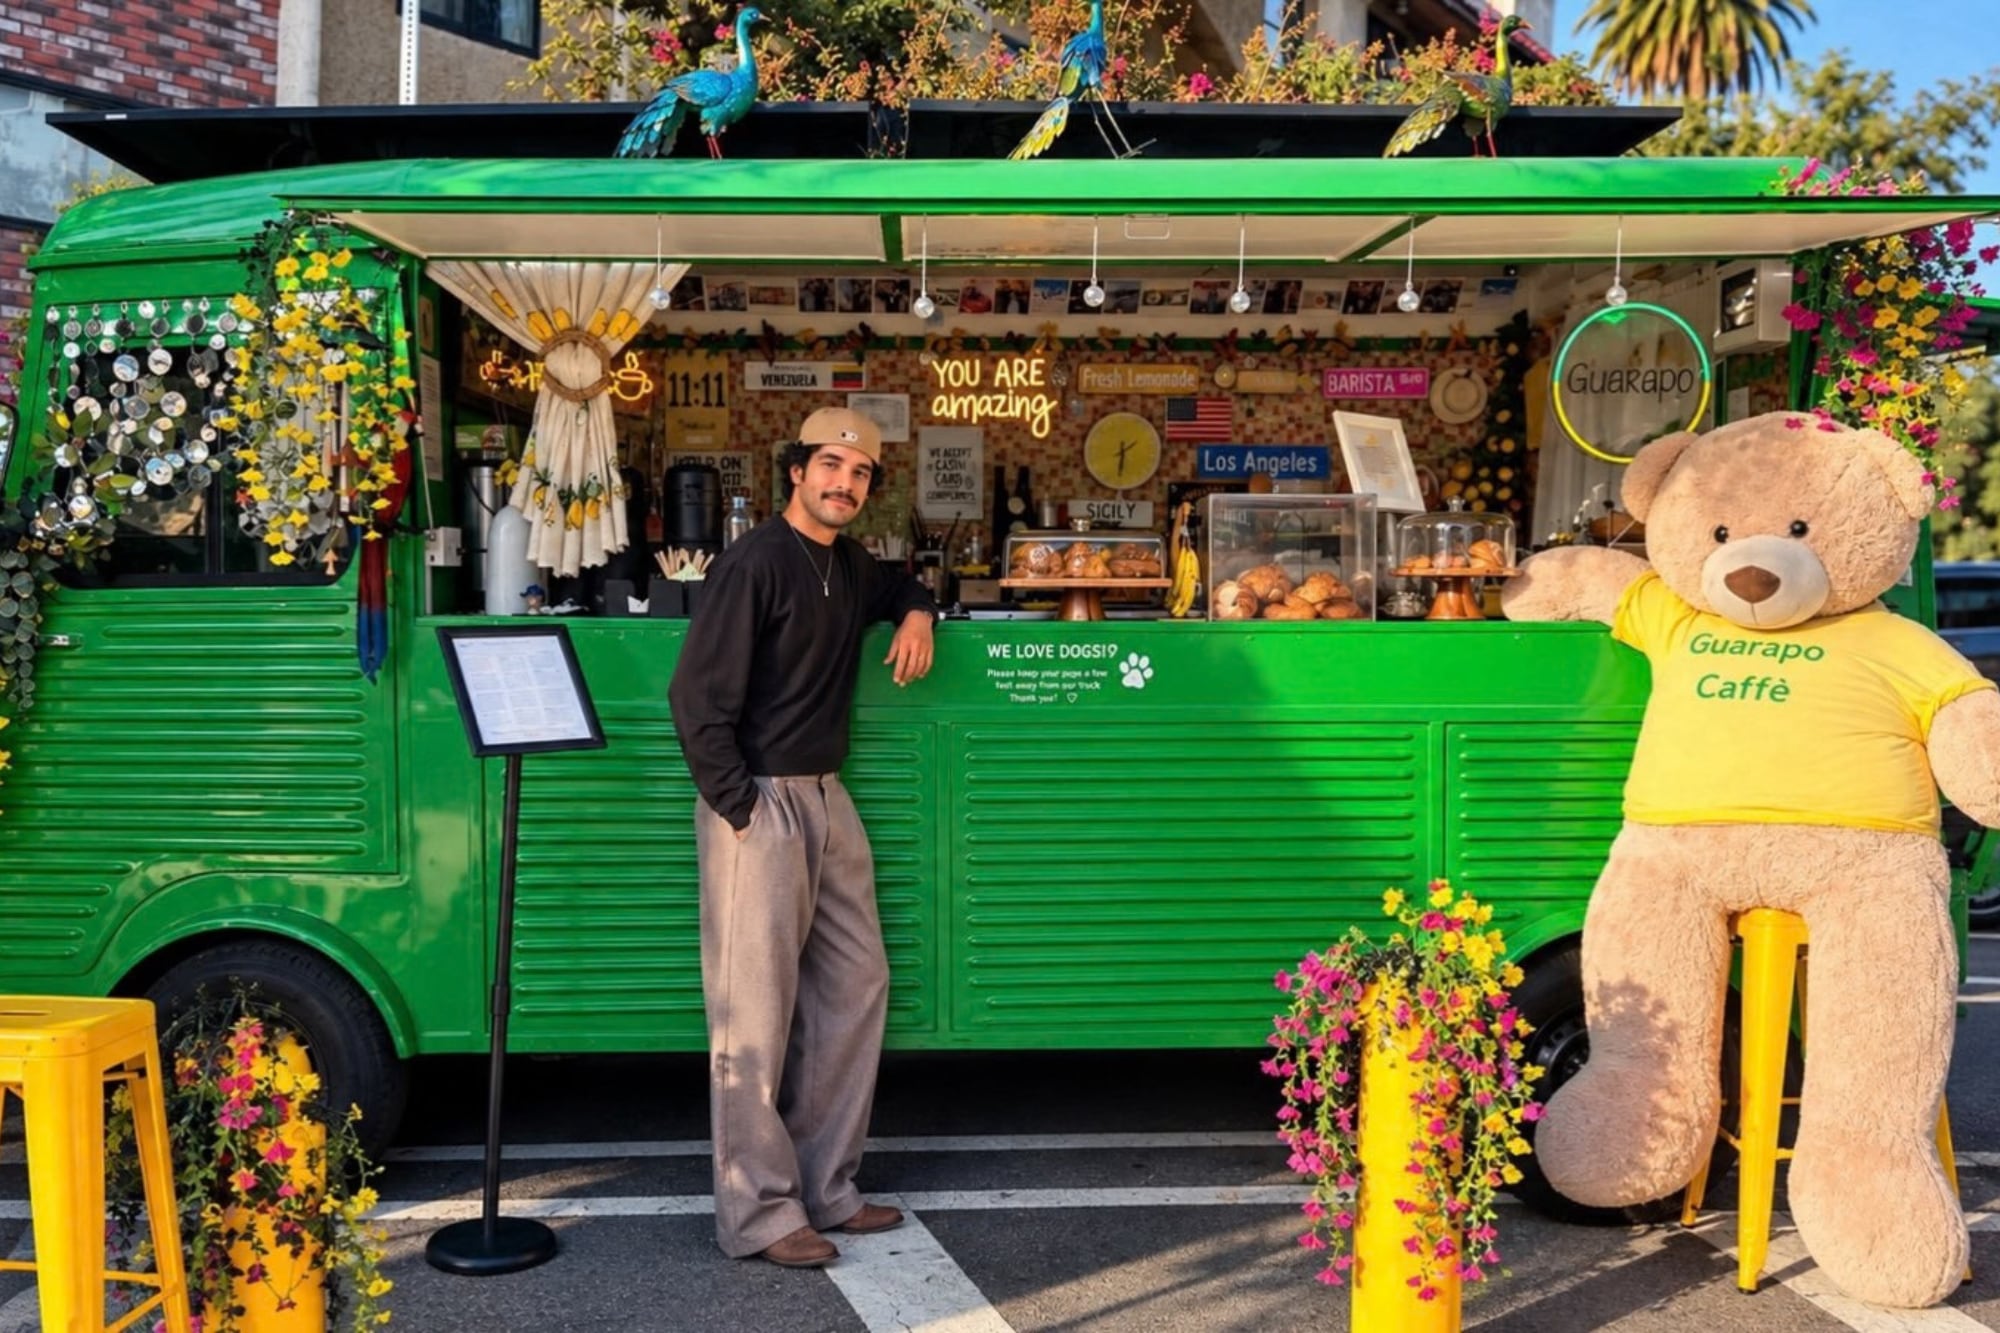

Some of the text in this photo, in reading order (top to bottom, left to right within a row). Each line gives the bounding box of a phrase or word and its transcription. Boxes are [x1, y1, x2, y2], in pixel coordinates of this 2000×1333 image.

[761, 373, 818, 387] VENEZUELA
[932, 358, 1046, 388] YOU ARE
[1083, 367, 1196, 388] Fresh Lemonade
[1328, 373, 1396, 393] BARISTA
[667, 371, 727, 408] 11:11
[931, 389, 1058, 438] amazing
[720, 455, 742, 470] ON
[1204, 450, 1318, 477] Los Angeles
[1086, 502, 1136, 519] SICILY
[987, 643, 1012, 659] WE
[1016, 643, 1055, 659] LOVE
[1690, 632, 1825, 664] Guarapo
[1695, 673, 1791, 703] Caffè
